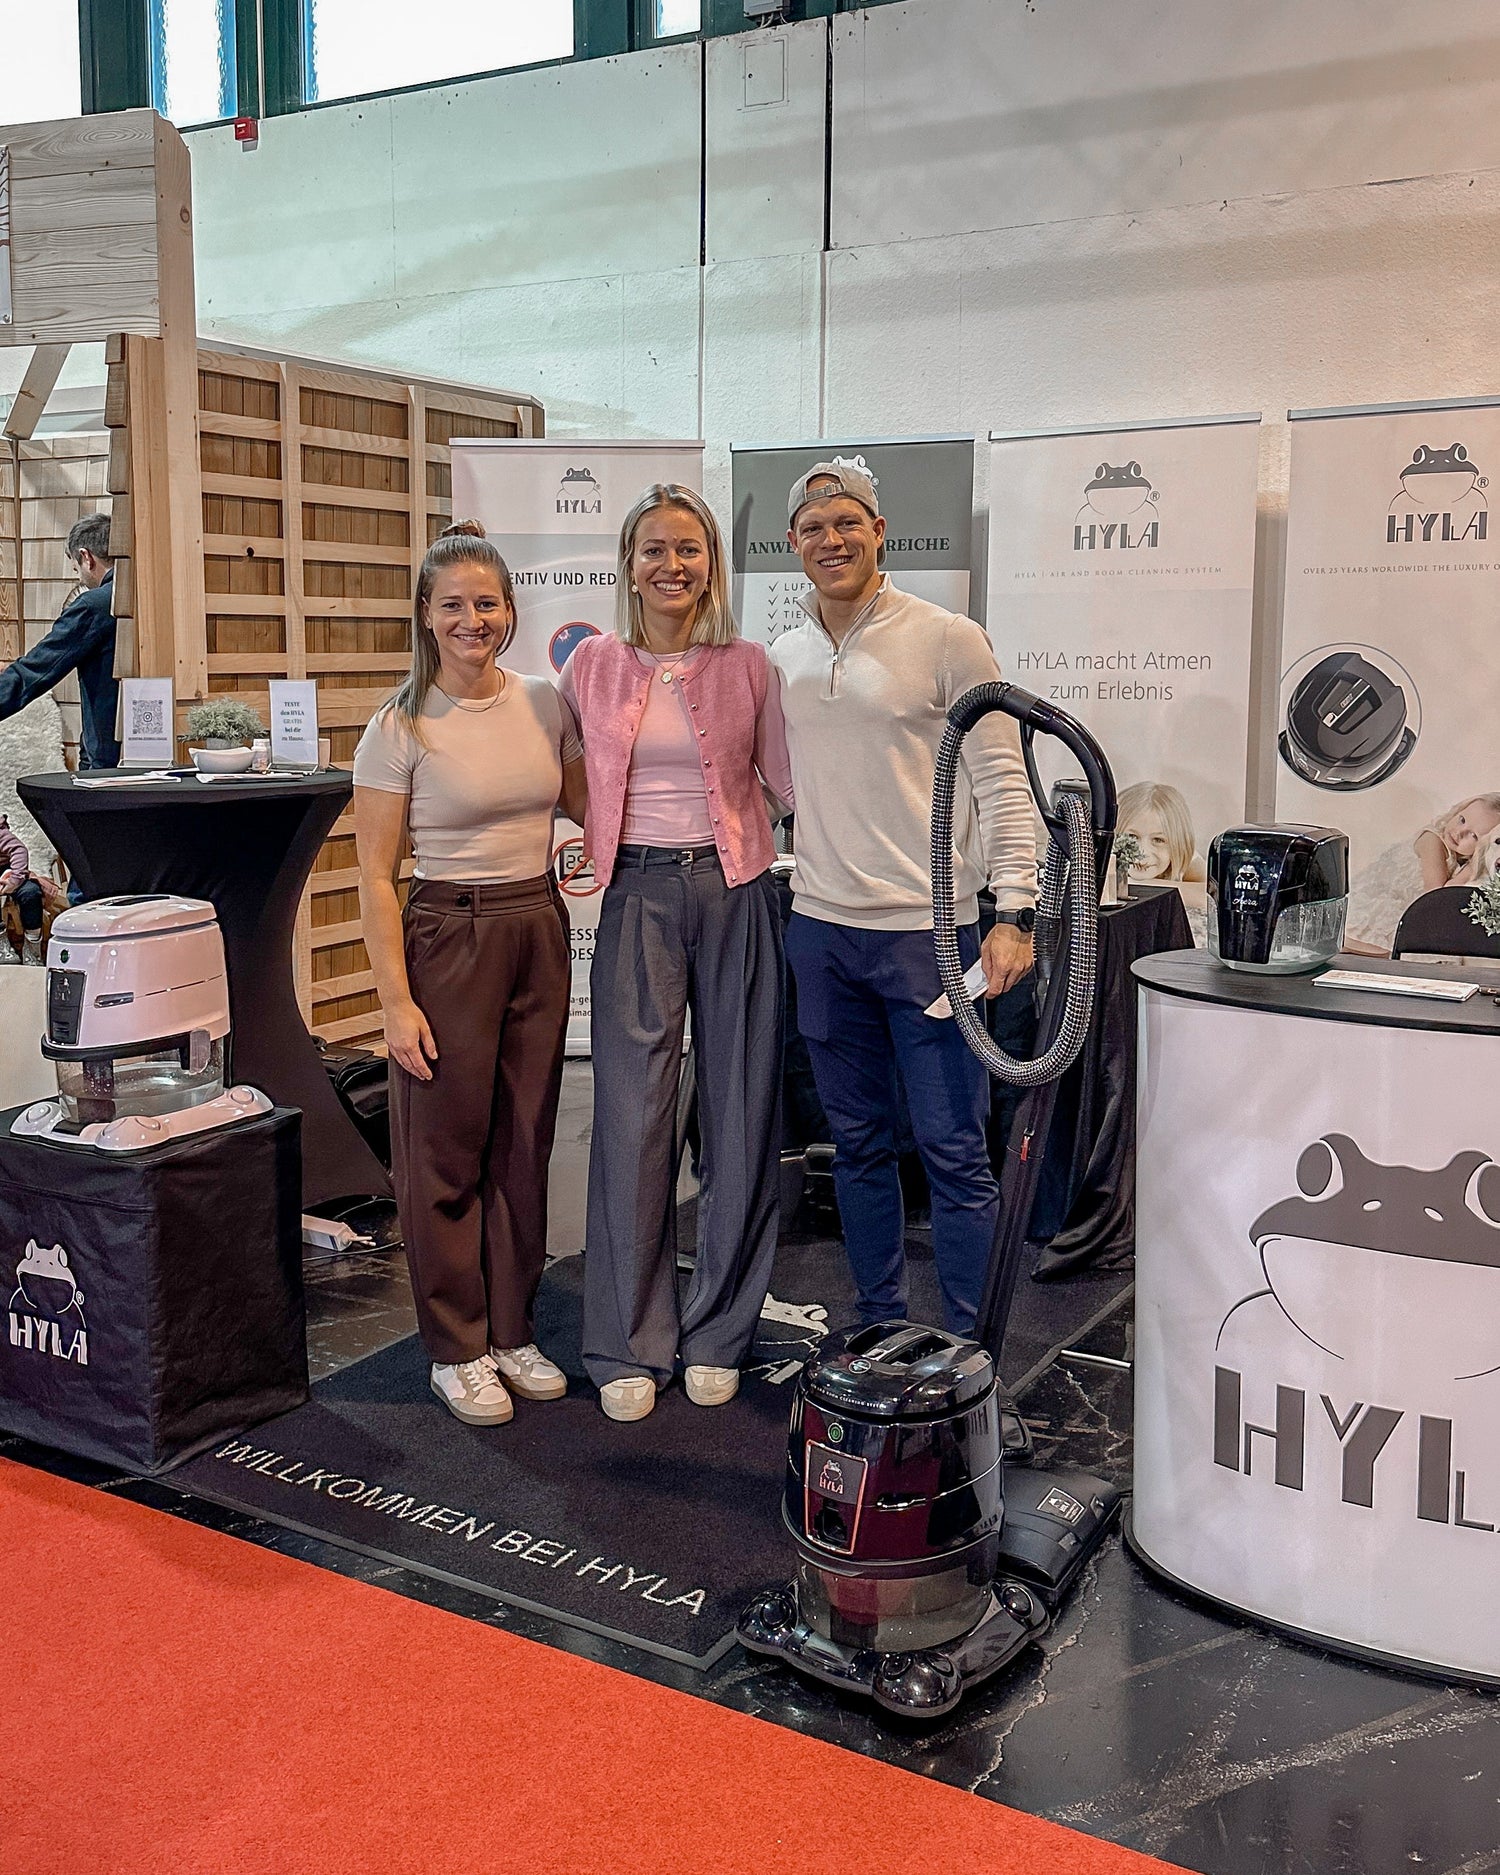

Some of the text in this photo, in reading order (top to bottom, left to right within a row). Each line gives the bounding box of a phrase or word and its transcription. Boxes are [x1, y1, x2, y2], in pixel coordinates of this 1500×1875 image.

[556, 499, 602, 514] HYLA
[1073, 521, 1160, 551] HYLA
[1386, 511, 1488, 543] HYLA
[553, 572, 584, 586] UND
[589, 572, 617, 586] RED
[1127, 567, 1179, 576] CLEANING
[1184, 566, 1222, 574] SYSTEM
[1303, 567, 1326, 575] OVER
[1341, 566, 1369, 574] YEARS
[1371, 564, 1428, 573] WORLDWIDE
[1432, 564, 1451, 572] THE
[1454, 563, 1490, 571] LUXURY
[1017, 650, 1212, 670] HYLA macht Atmen
[1050, 681, 1173, 701] zum Erlebnis
[1234, 880, 1259, 891] HYLA
[8, 1312, 88, 1366] HYLA
[1213, 1364, 1500, 1535] HYL
[819, 1477, 844, 1494] HYLA
[215, 1439, 708, 1616] WILLKOMMEN BEI HYLA
